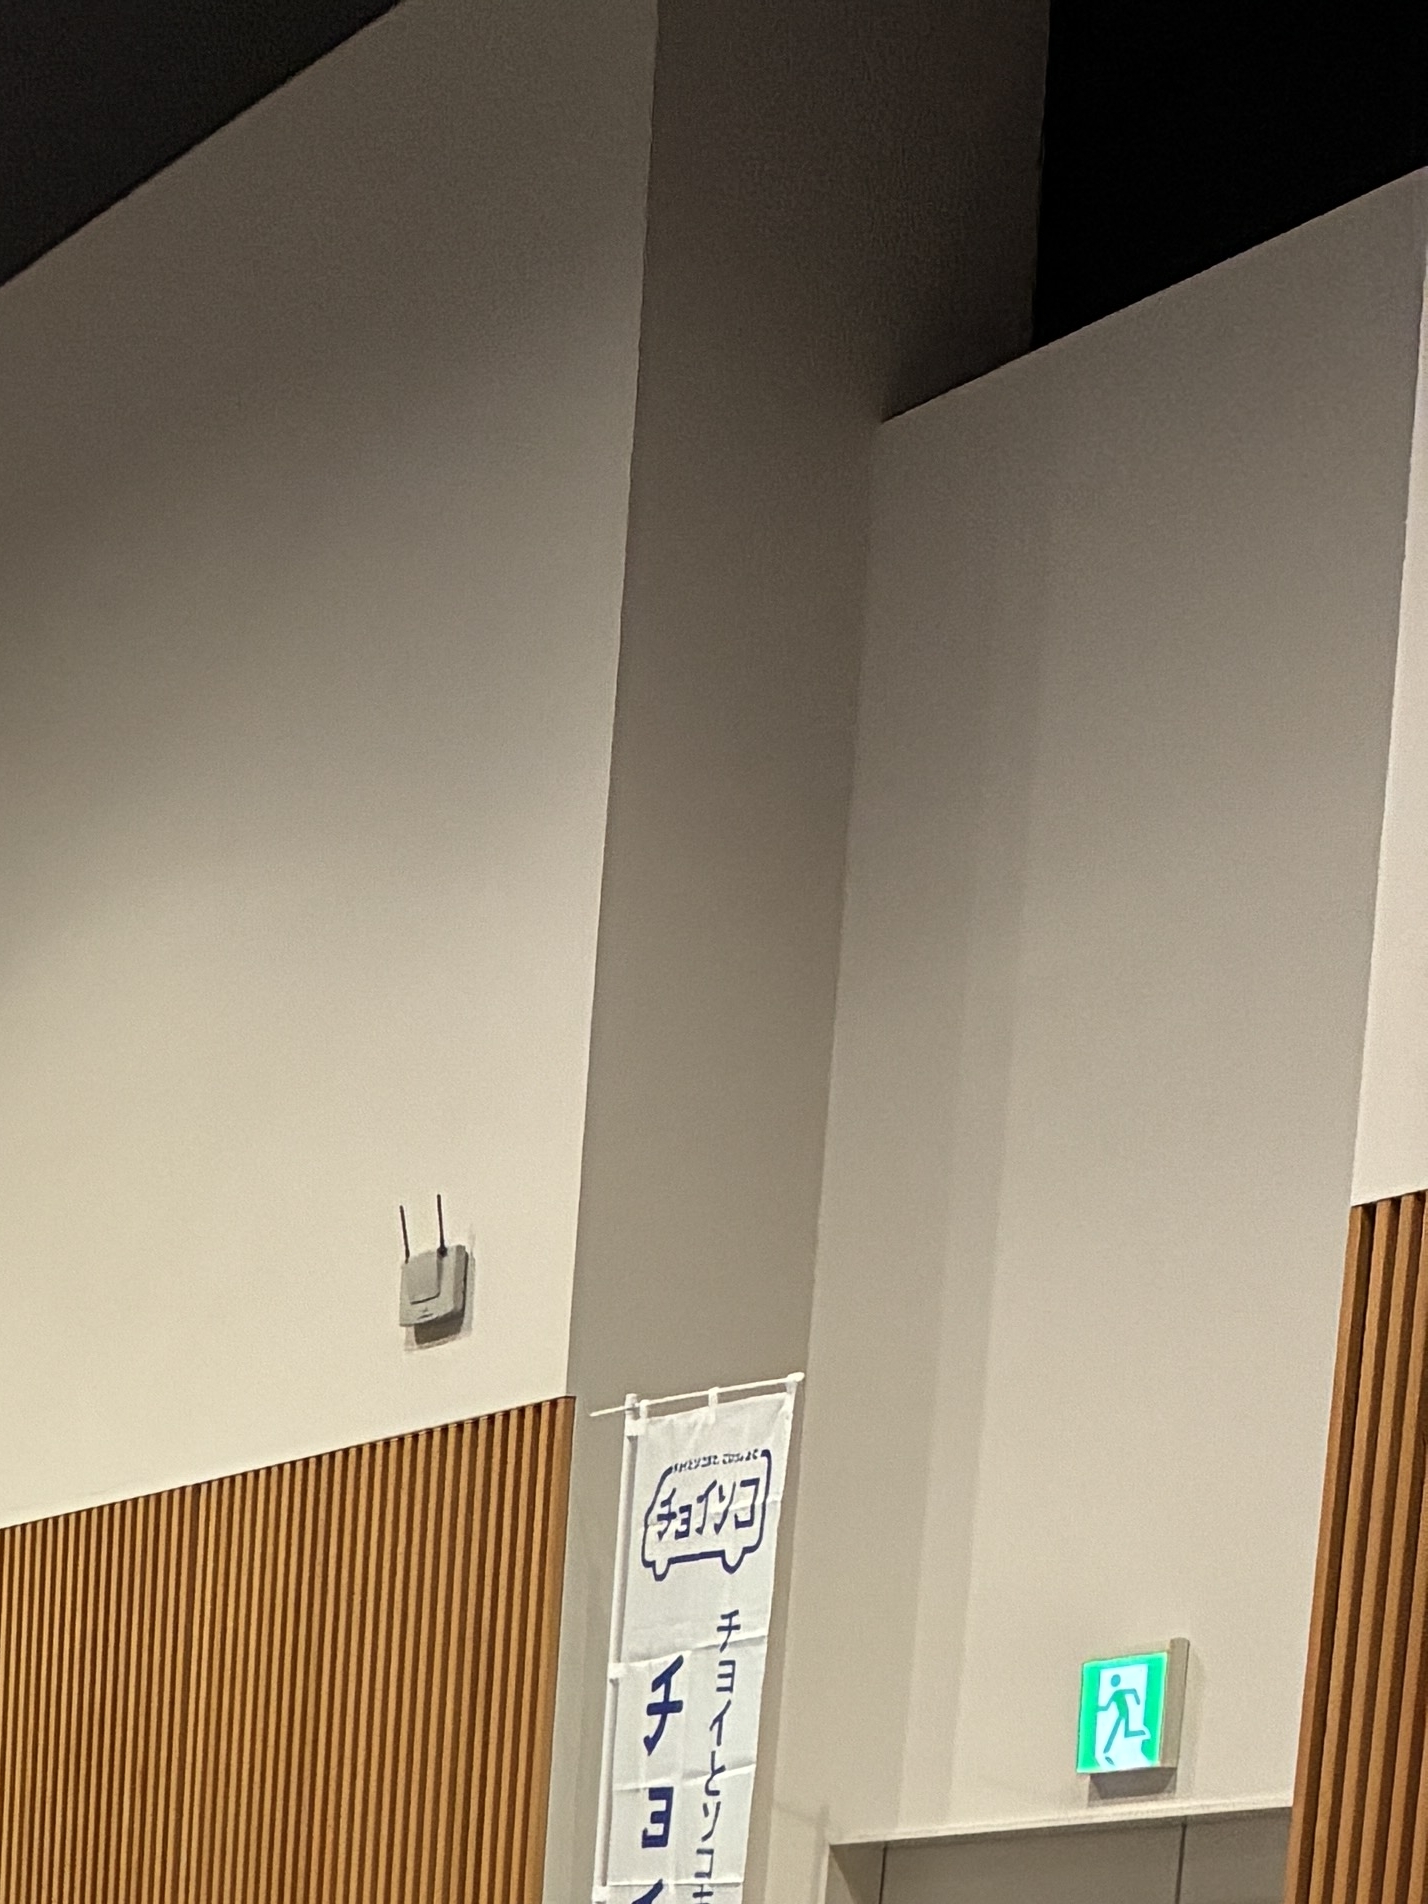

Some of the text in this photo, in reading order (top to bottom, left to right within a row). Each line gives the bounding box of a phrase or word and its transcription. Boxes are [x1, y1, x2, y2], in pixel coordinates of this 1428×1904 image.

[656, 1476, 761, 1542] チョイソコ
